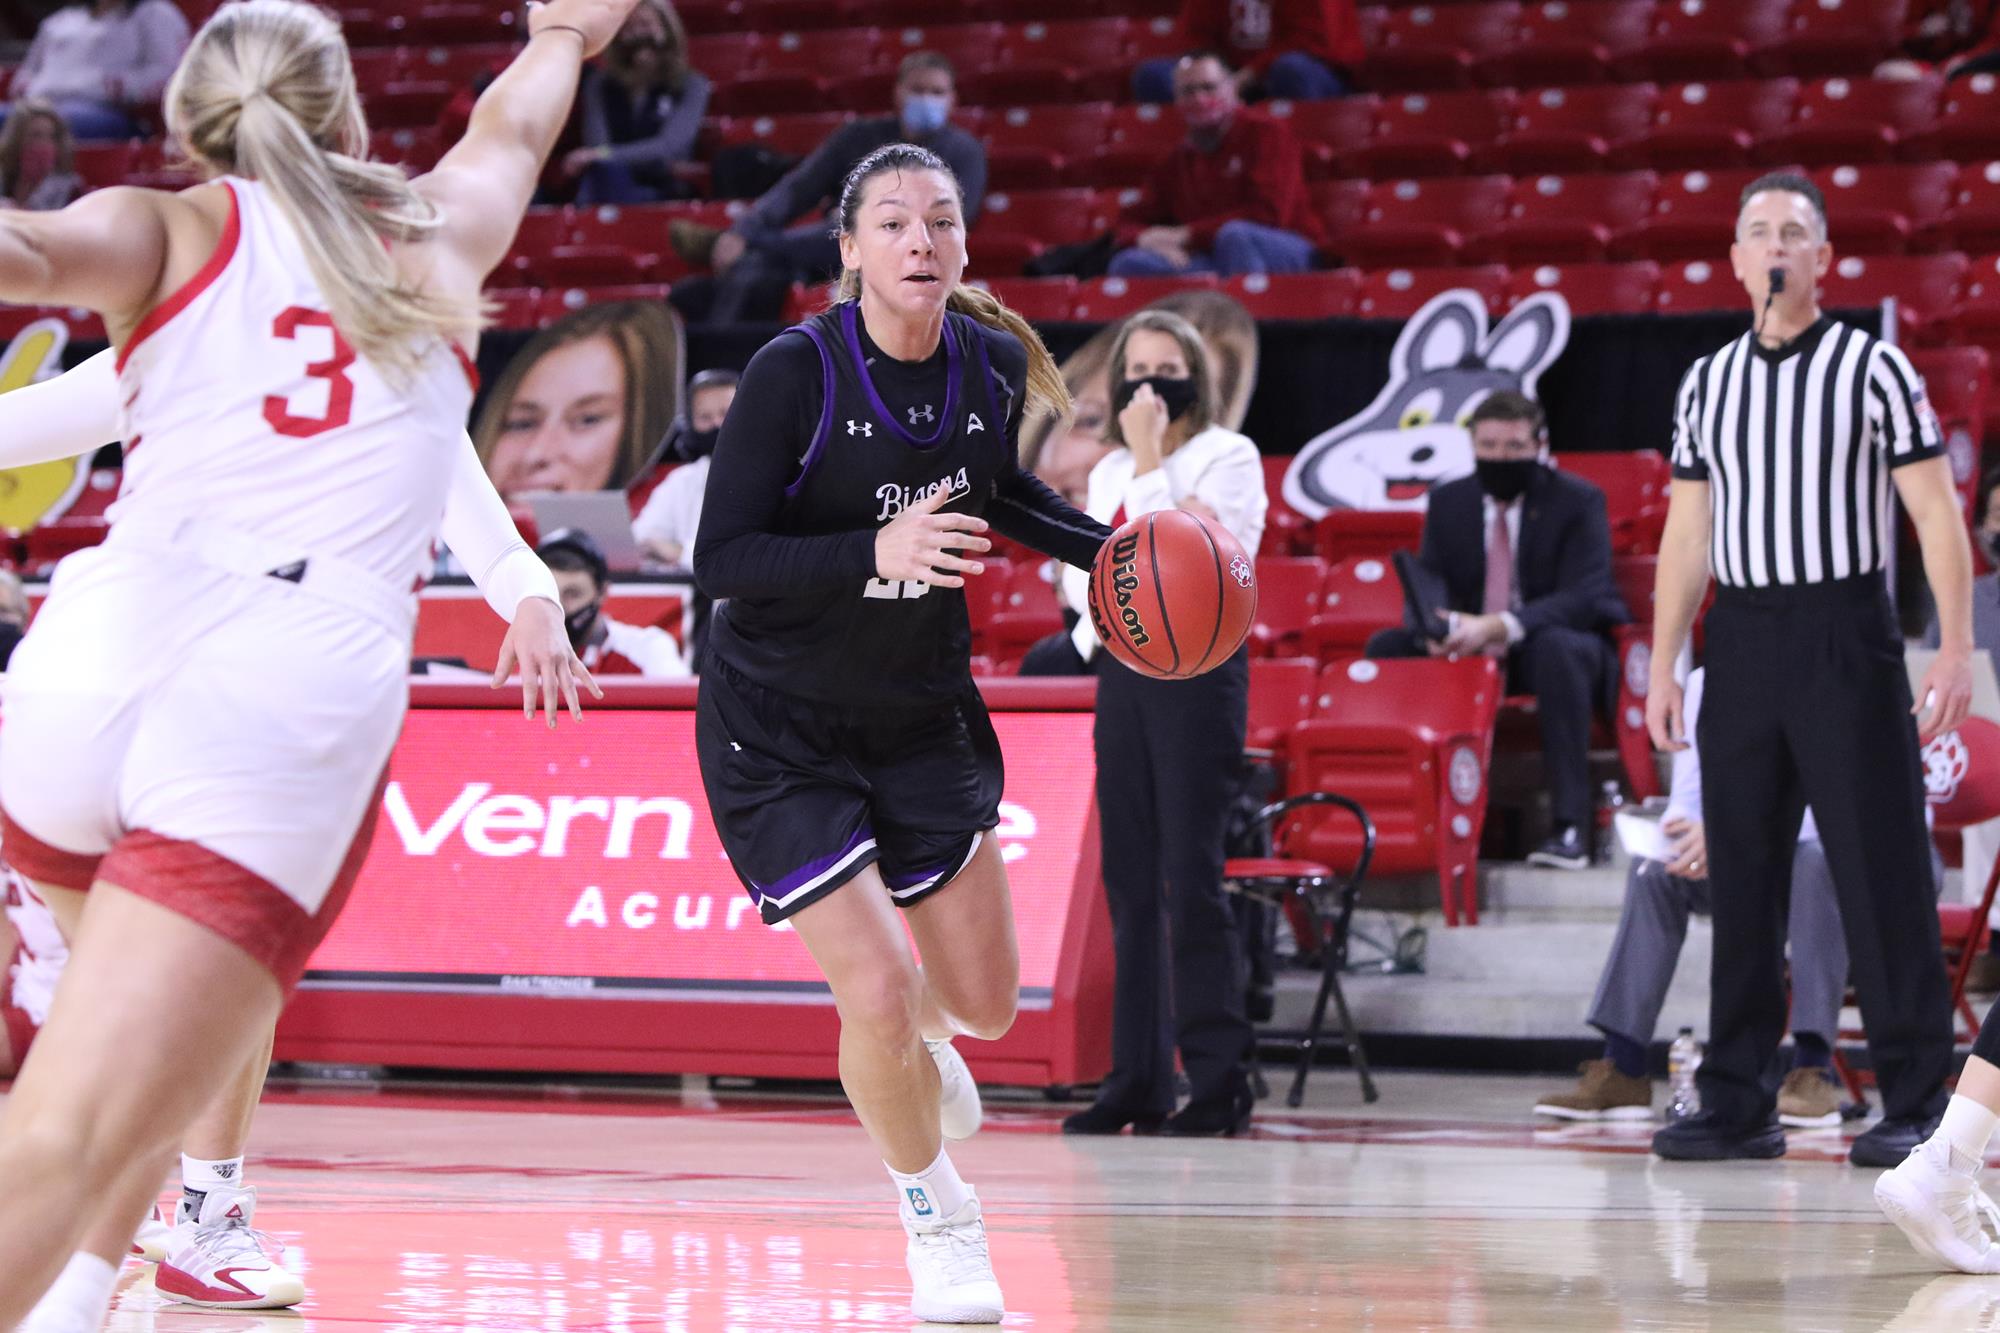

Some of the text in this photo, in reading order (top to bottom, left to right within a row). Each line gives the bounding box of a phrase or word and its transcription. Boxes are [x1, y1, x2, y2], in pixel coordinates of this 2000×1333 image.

[262, 306, 357, 438] 3
[1112, 531, 1150, 648] Wilson
[385, 781, 694, 860] Vern
[566, 886, 795, 932] Acur
